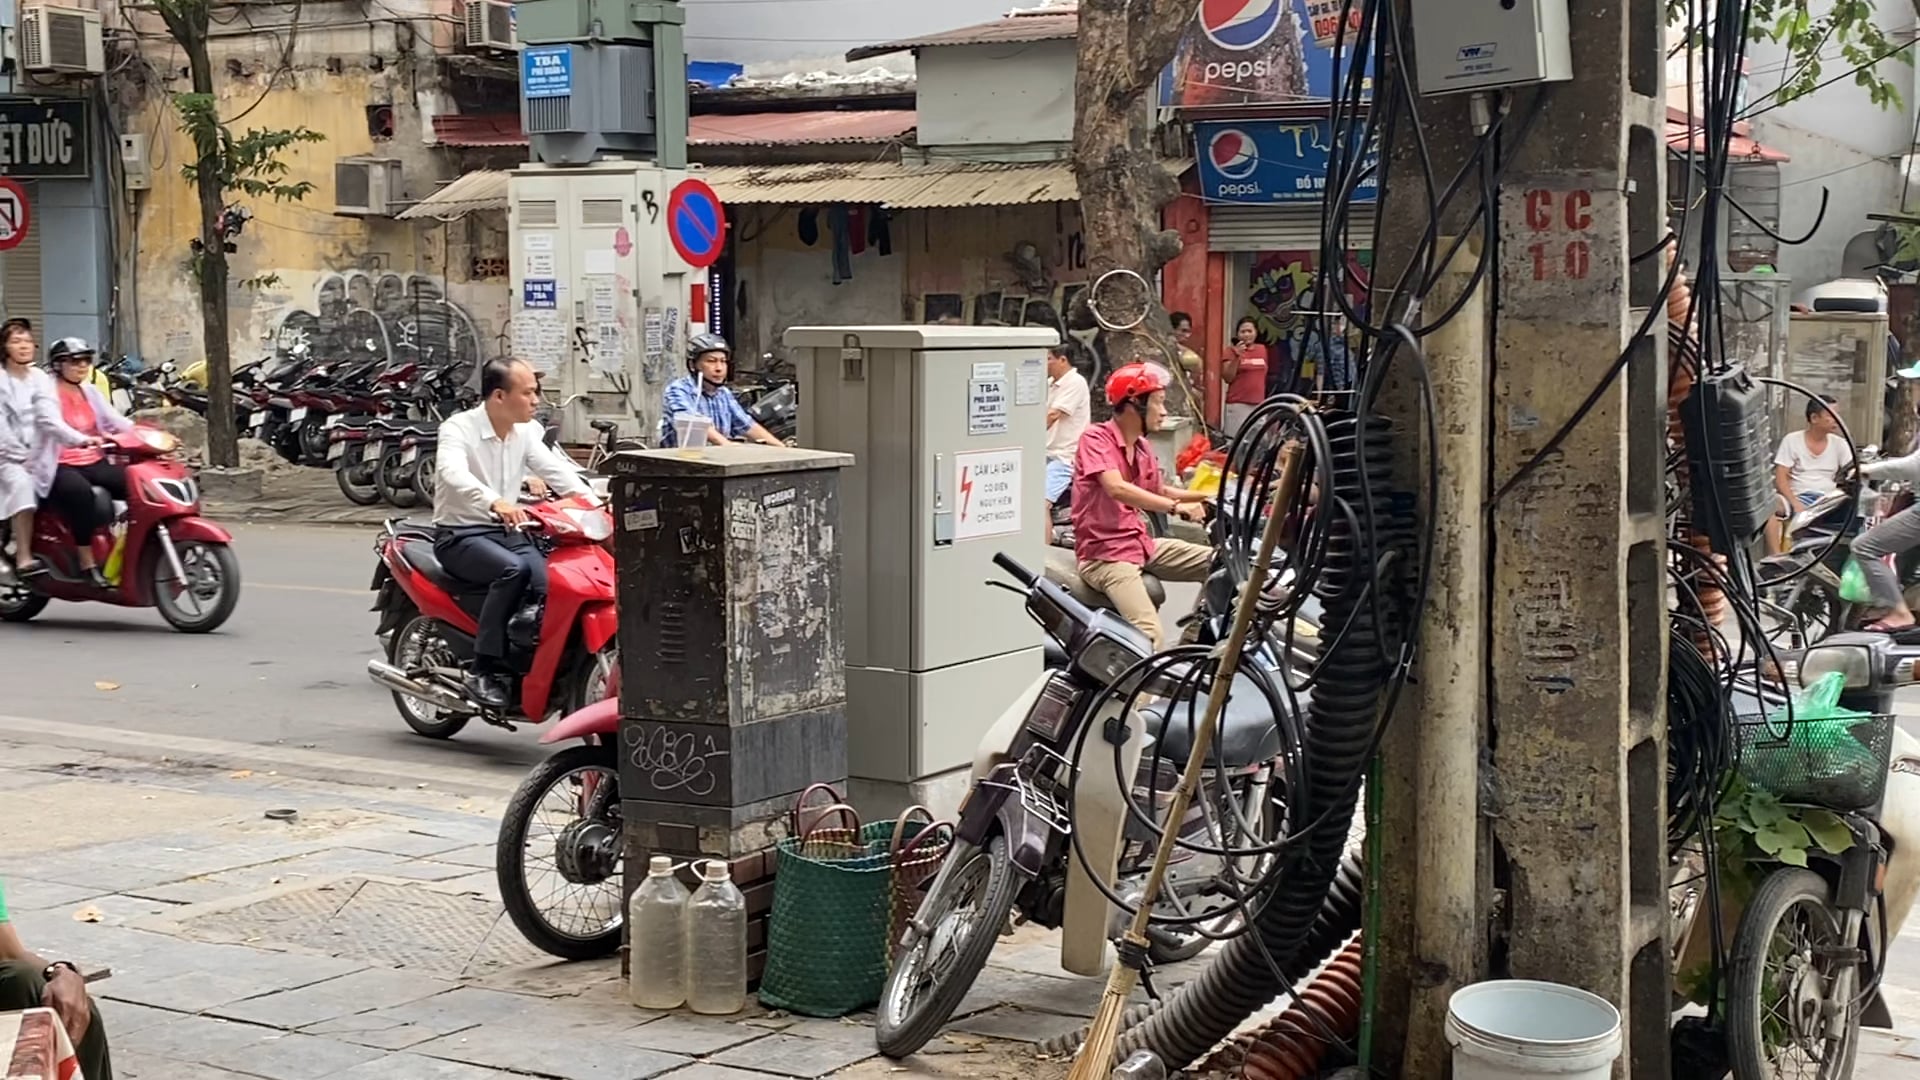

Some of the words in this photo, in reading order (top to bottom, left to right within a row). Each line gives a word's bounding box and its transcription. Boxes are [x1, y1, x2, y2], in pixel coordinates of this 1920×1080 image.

[533, 55, 562, 66] TBA
[1204, 55, 1272, 84] pepsi
[27, 108, 73, 165] ĐỨC
[1218, 182, 1260, 197] pepsi
[979, 383, 1000, 393] TBA
